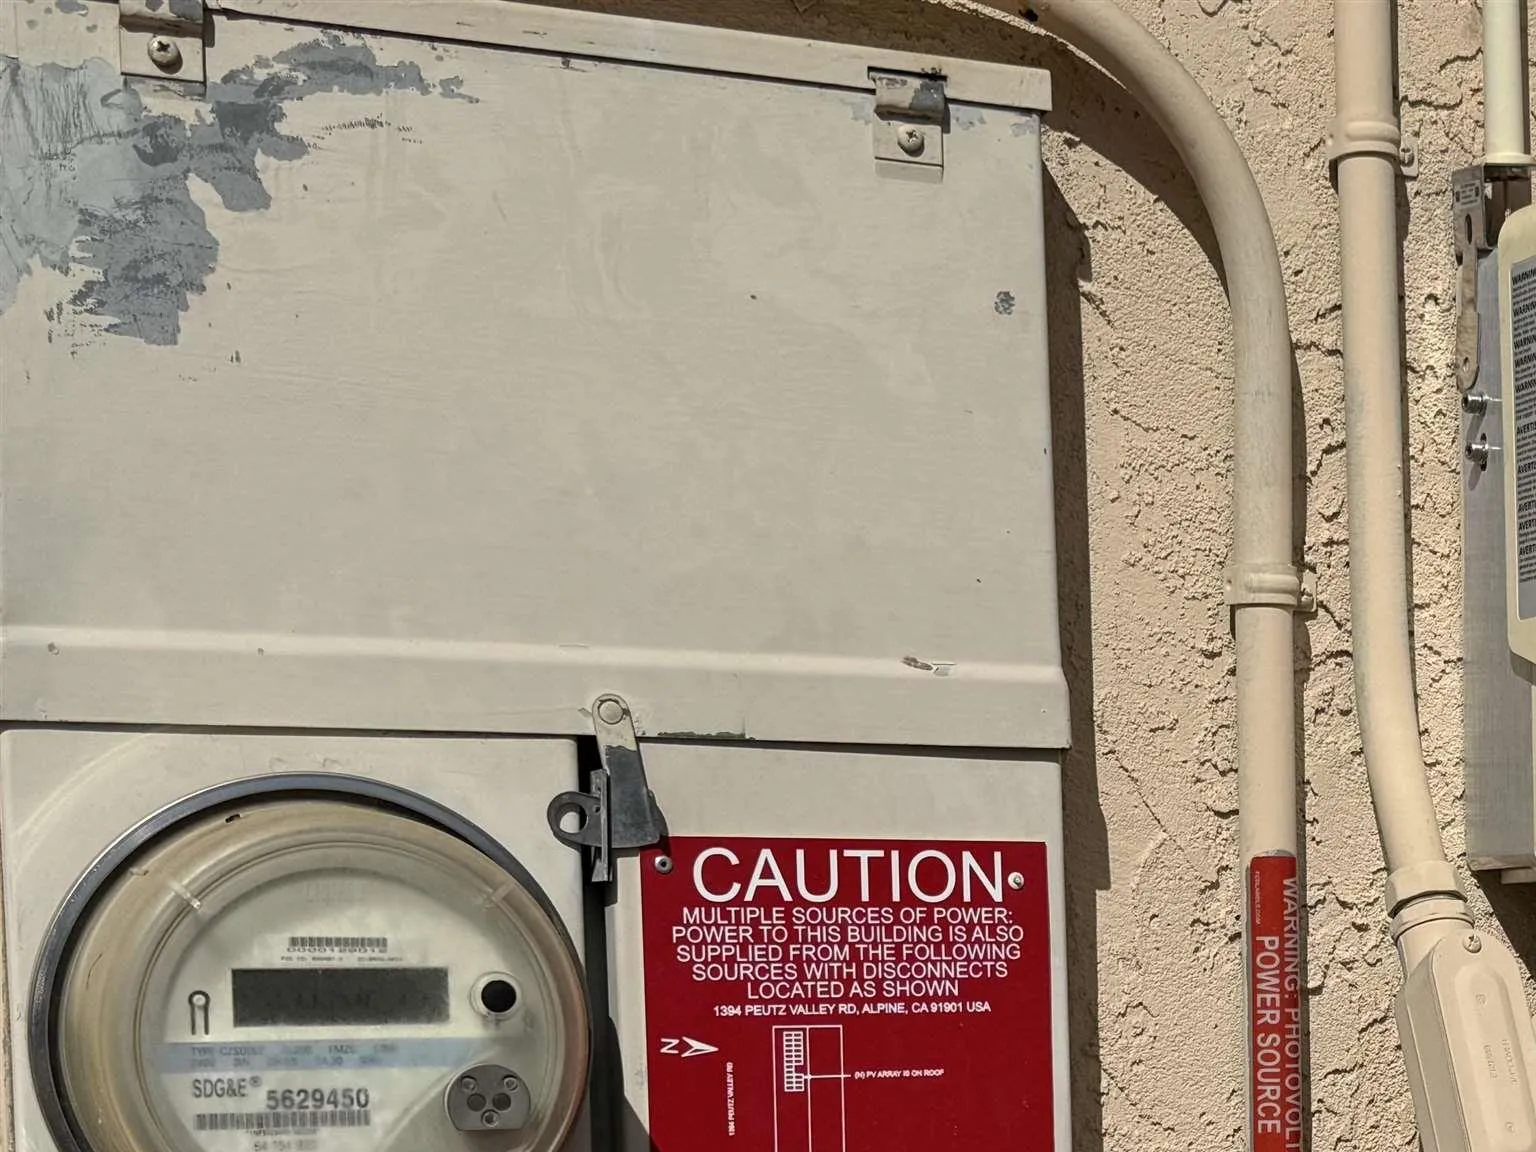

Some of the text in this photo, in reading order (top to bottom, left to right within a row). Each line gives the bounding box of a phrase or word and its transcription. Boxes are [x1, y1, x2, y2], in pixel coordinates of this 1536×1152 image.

[692, 846, 1003, 903] CAUTION
[682, 906, 786, 924] MULTIPLE
[791, 906, 894, 924] SOURCES
[899, 906, 927, 924] OF
[672, 924, 1024, 943] POWER TO THIS BUILDING IS ALSO
[676, 943, 1021, 962] SUPPLIED FROM THE FOLLOWING
[692, 961, 1008, 981] SOURCES WITH DISCONNECTS
[747, 979, 959, 999] LOCATED AS SHOWN
[713, 1004, 742, 1017] 1394
[744, 1004, 787, 1016] PEUTZ
[788, 1003, 836, 1015] VALLEY
[911, 1001, 929, 1013] CA
[929, 1001, 963, 1013] 91901
[966, 1000, 991, 1012] USA
[1255, 935, 1282, 1135] POWER SOURCE
[266, 1087, 370, 1111] 5629450
